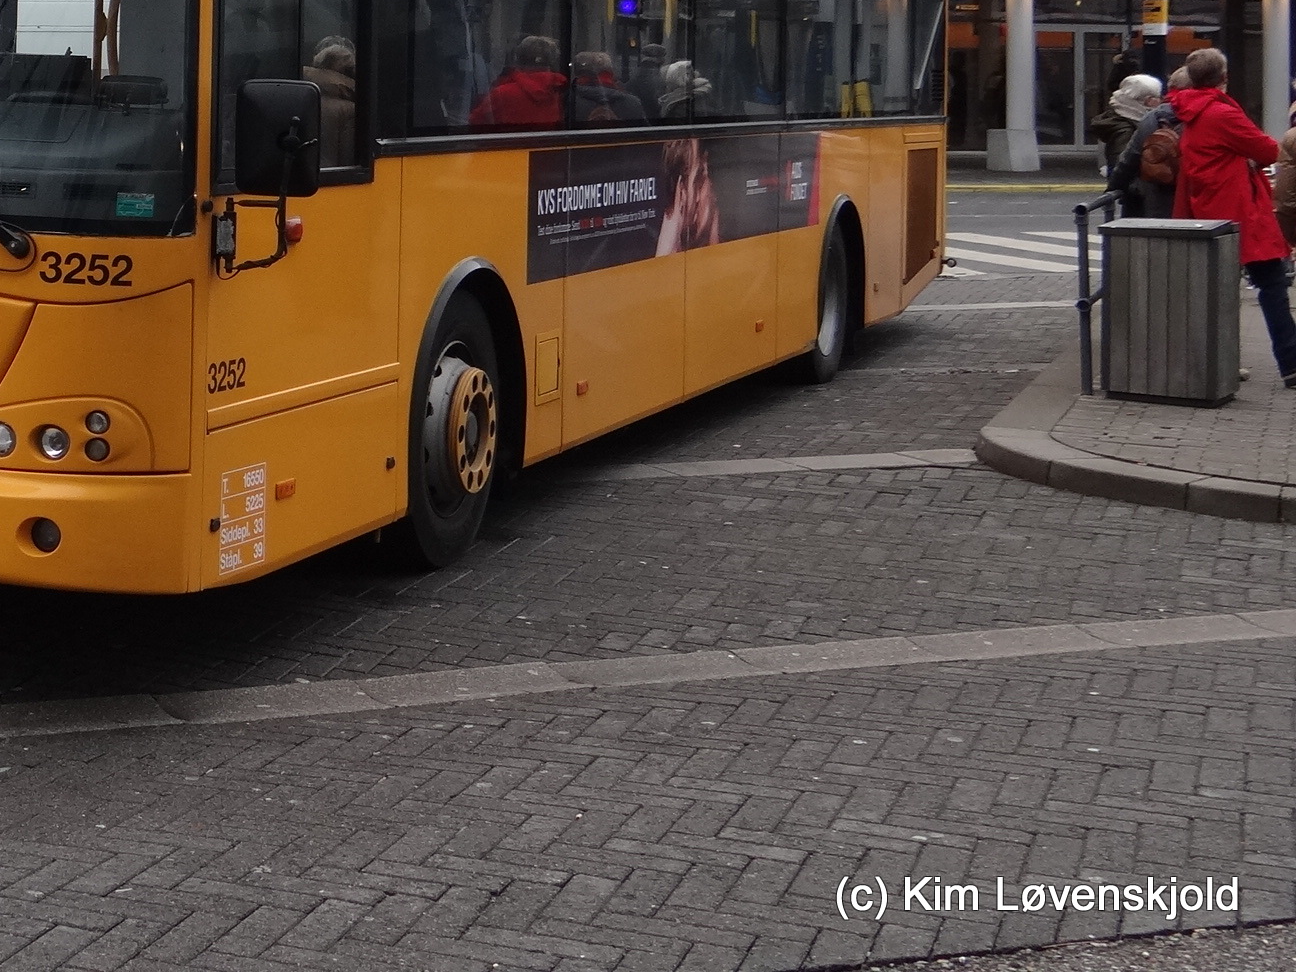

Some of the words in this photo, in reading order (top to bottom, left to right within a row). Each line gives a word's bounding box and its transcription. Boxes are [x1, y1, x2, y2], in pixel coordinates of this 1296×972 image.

[537, 188, 555, 215] KYS
[557, 183, 602, 214] FORDOMME
[603, 181, 615, 207] OM
[616, 179, 630, 205] HIV
[630, 176, 657, 203] FARVEL
[38, 250, 134, 287] 3252
[207, 357, 247, 395] 3252
[242, 468, 264, 489] 16550
[245, 493, 264, 513] 5225
[220, 521, 251, 545] Siddepl.
[253, 517, 263, 535] 33
[253, 541, 263, 559] 39
